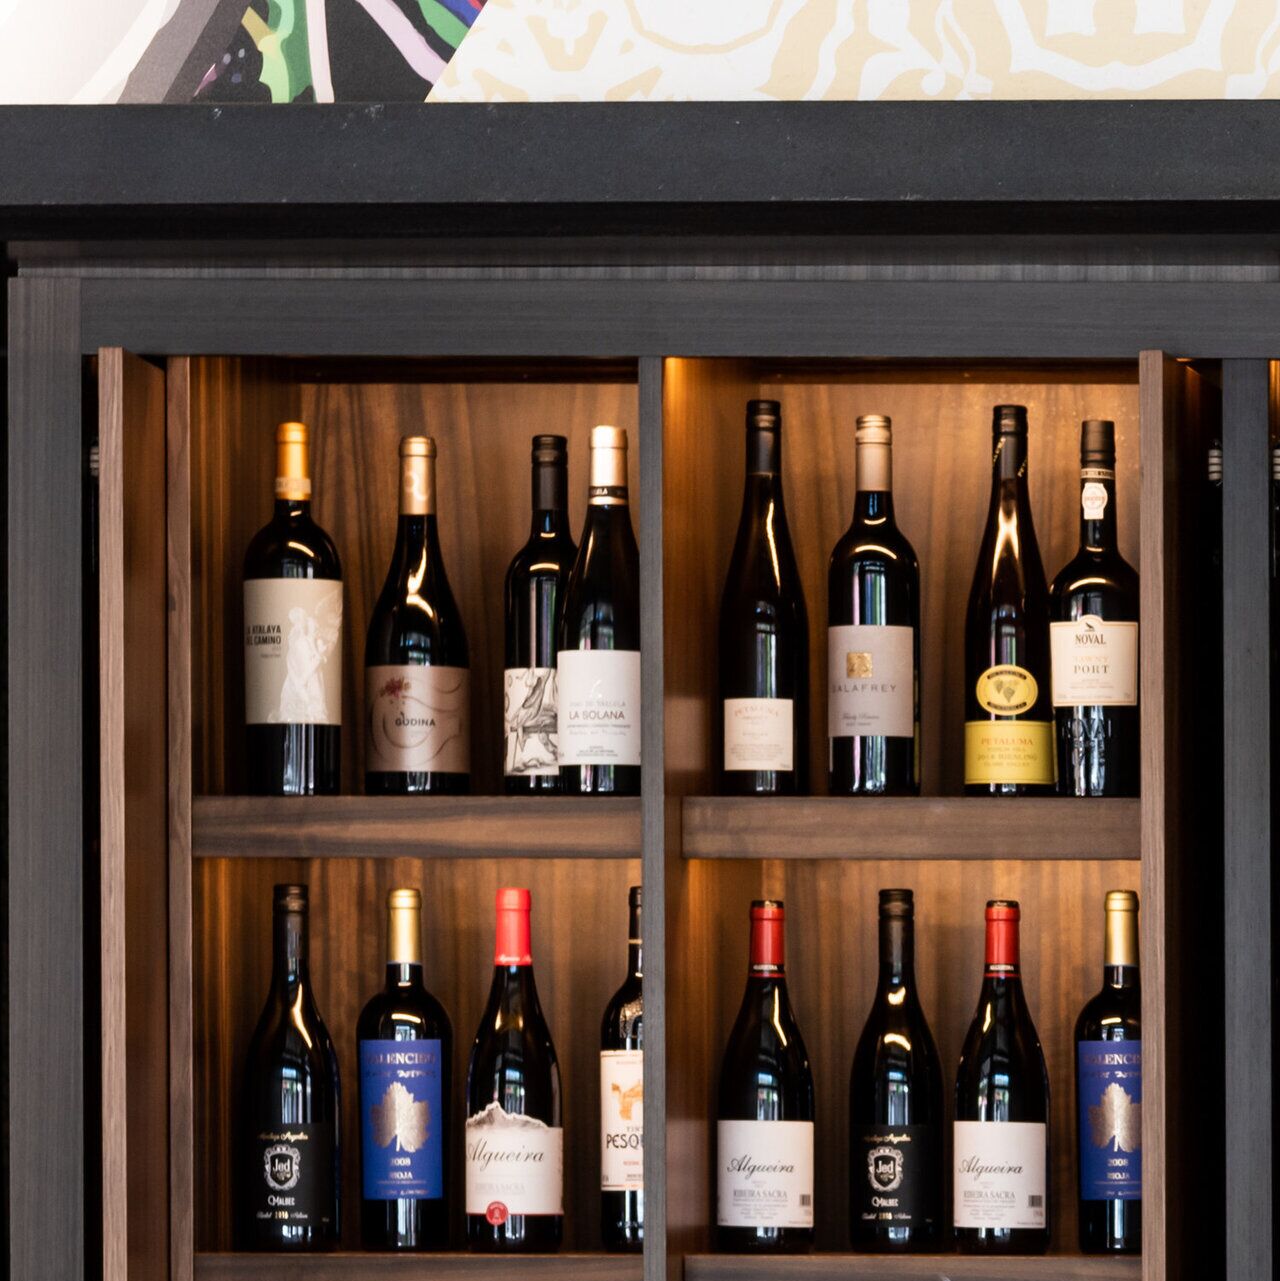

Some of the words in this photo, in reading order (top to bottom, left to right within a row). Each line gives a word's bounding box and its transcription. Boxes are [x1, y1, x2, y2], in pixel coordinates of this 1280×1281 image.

[1075, 633, 1107, 645] NOVAL
[1073, 664, 1109, 674] PORT
[466, 1137, 545, 1172] Algueira
[727, 1154, 794, 1180] Algueira
[876, 1160, 894, 1174] Jed
[958, 1156, 1024, 1182] Algueira
